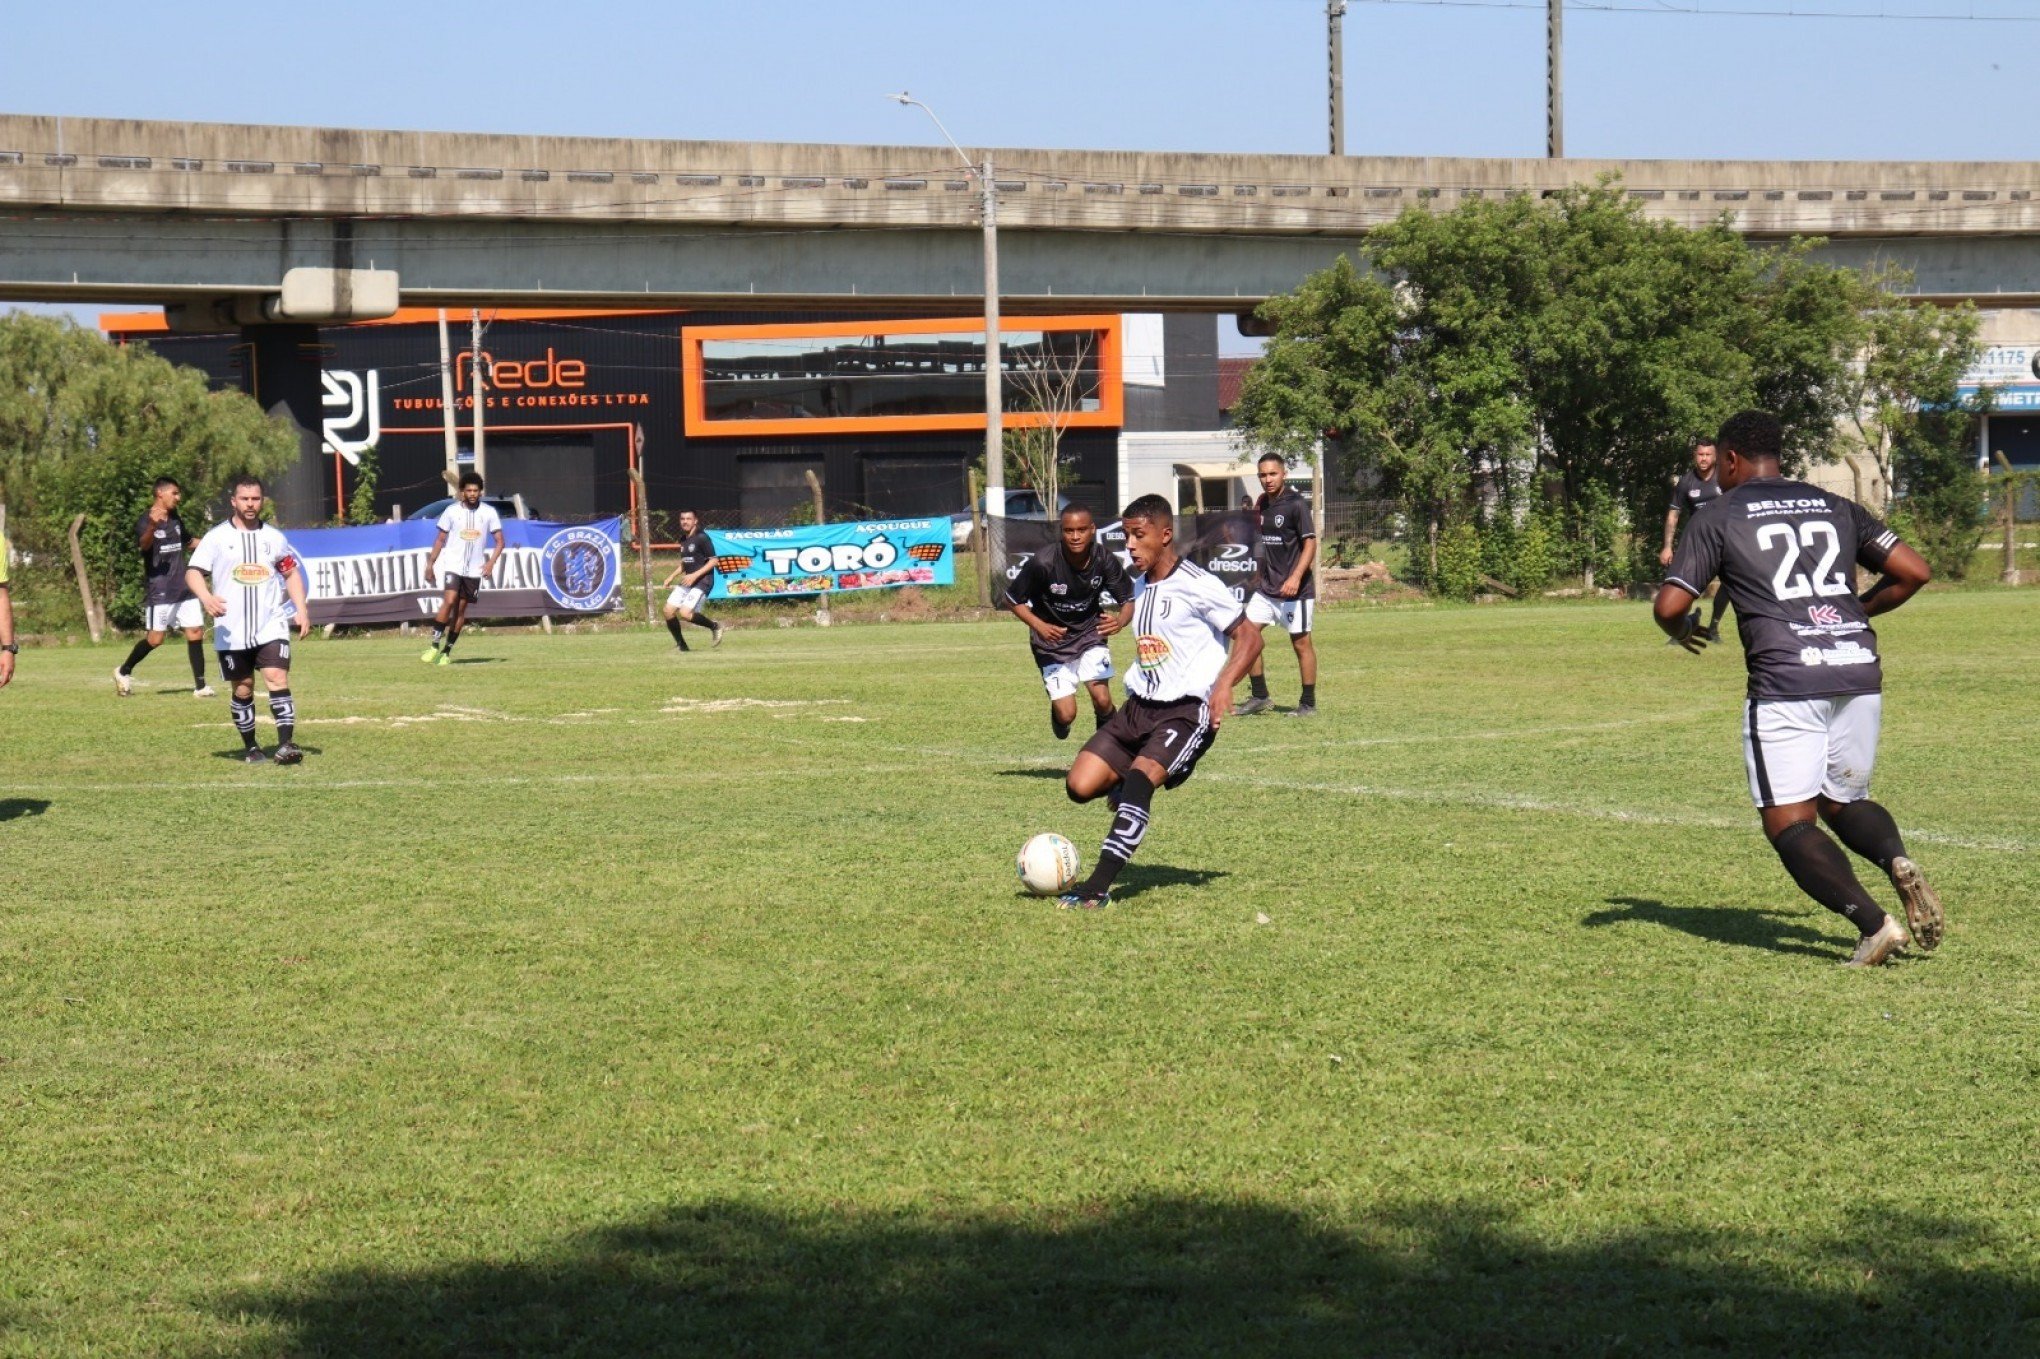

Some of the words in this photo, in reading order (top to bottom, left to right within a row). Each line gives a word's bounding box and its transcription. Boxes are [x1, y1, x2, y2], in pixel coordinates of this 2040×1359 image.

[517, 393, 599, 407] CONEXÕES
[605, 394, 649, 404] LTDA
[1746, 498, 1827, 512] BELTON
[855, 520, 932, 533] AÇOUGUE
[1208, 556, 1258, 572] dresch
[1756, 521, 1851, 601] 22
[1166, 728, 1178, 748] 7
